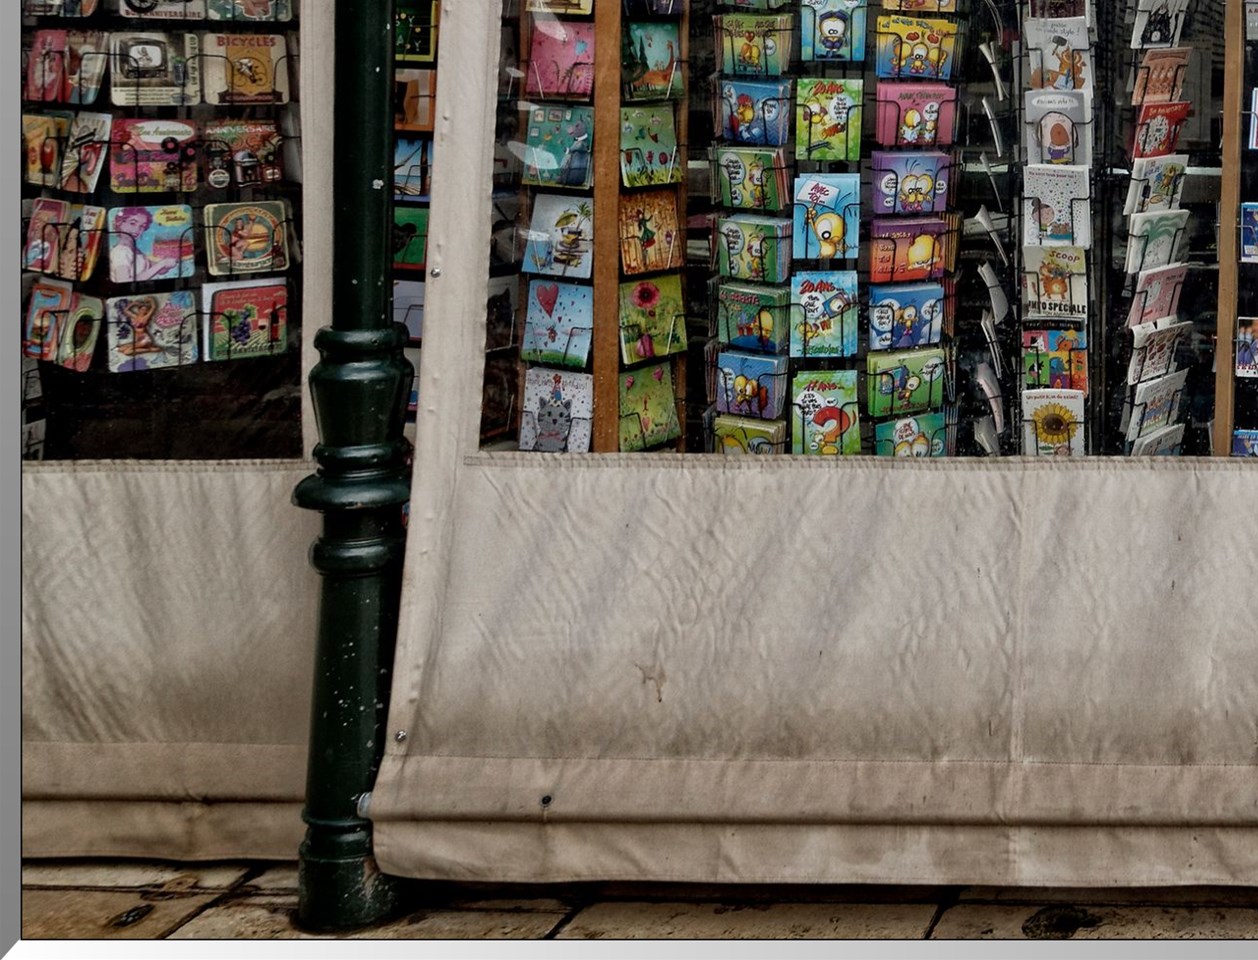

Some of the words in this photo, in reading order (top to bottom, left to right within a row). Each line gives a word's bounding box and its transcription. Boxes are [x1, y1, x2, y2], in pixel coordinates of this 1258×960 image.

[216, 36, 277, 47] BICYCLES
[810, 182, 830, 196] AVEC
[1049, 250, 1081, 263] SCOOP
[1028, 300, 1046, 311] INO
